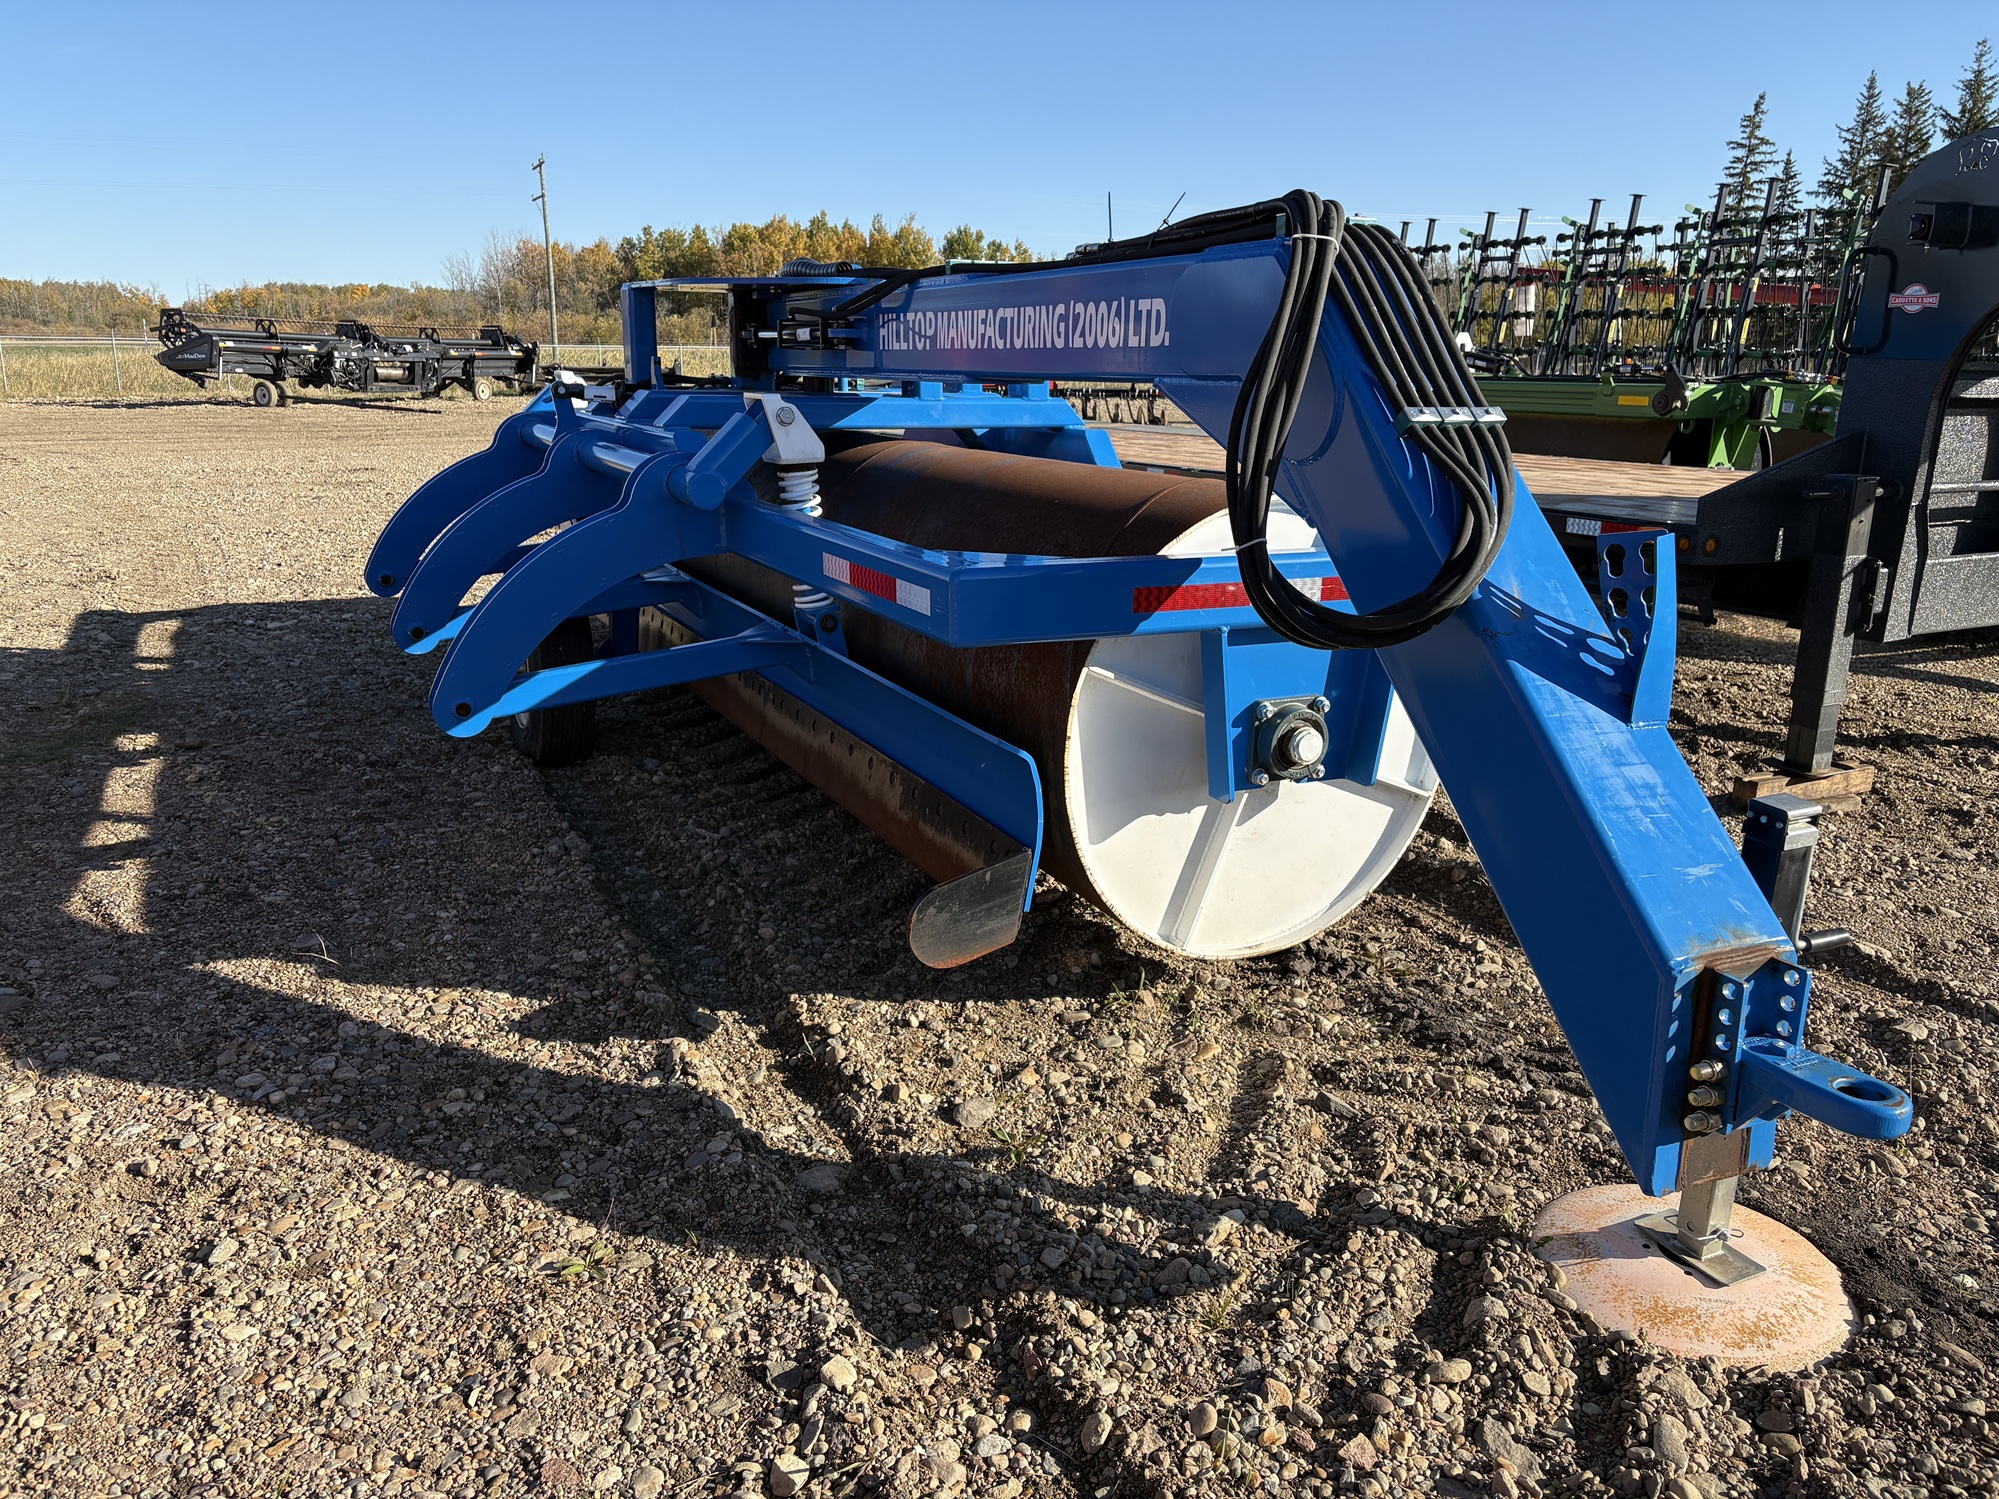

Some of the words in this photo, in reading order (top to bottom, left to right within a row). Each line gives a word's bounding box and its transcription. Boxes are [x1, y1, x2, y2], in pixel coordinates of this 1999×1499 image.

[1923, 296, 1937, 304] SONS
[879, 311, 936, 351] HILLTOP
[937, 303, 1066, 350] MANUFACTURING
[1069, 296, 1125, 349] (2006)
[1128, 298, 1170, 347] LTD.
